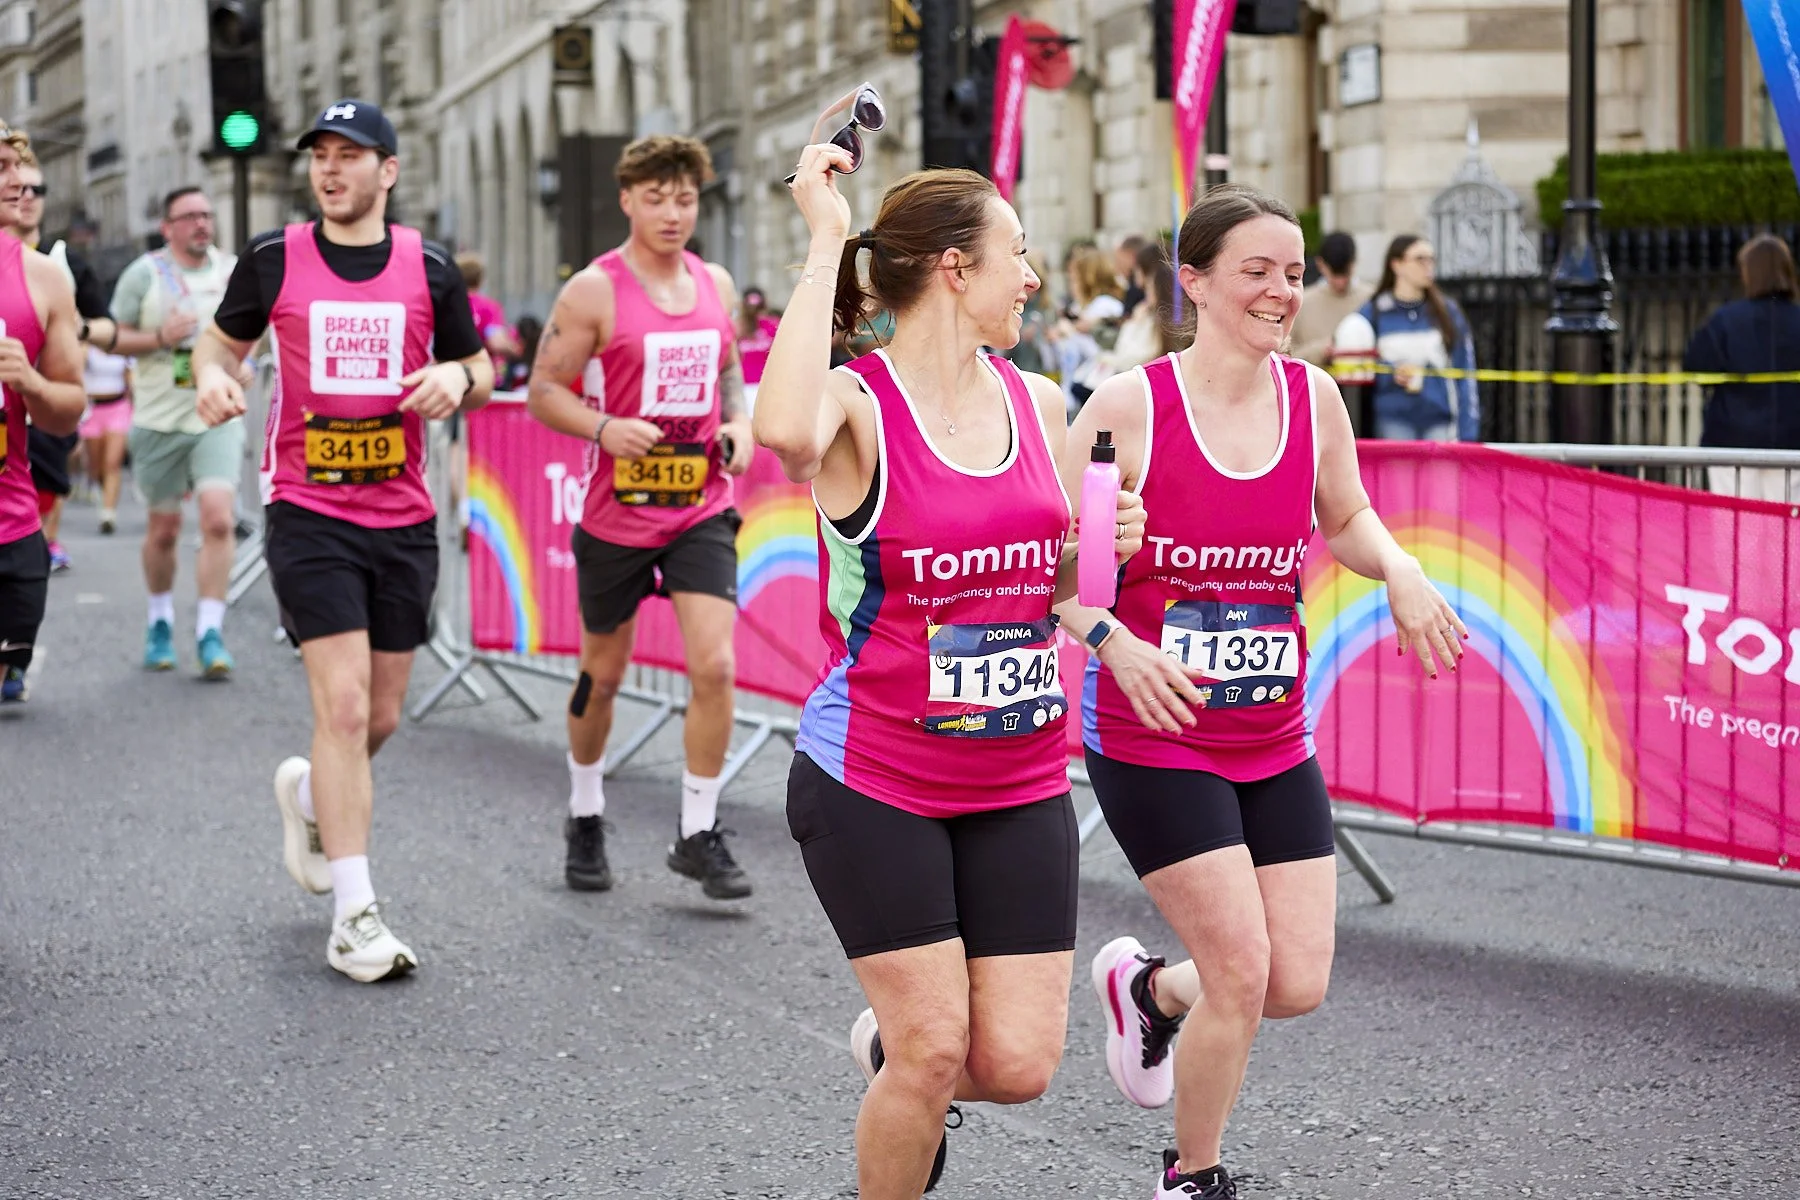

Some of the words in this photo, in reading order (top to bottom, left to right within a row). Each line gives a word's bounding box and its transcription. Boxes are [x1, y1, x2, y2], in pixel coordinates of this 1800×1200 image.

[325, 316, 390, 334] BREAST
[325, 336, 390, 353] CANCER
[658, 345, 711, 362] BREAST
[335, 358, 381, 379] NOW
[658, 363, 708, 381] CANCER
[653, 420, 700, 440] OSS
[320, 437, 390, 461] 3419
[629, 461, 694, 485] 3418
[1147, 536, 1307, 577] Tommy's
[907, 593, 929, 606] The
[932, 586, 993, 608] pregnancy
[996, 583, 1021, 596] and
[1170, 576, 1223, 593] pregnancy
[1226, 580, 1246, 590] and
[1249, 580, 1275, 592] baby
[986, 627, 1033, 642] DONNA
[1664, 583, 1800, 686] To
[1174, 633, 1290, 671] 11337
[944, 650, 1056, 698] 11346
[1663, 694, 1715, 729] The
[1720, 711, 1800, 748] pregn
